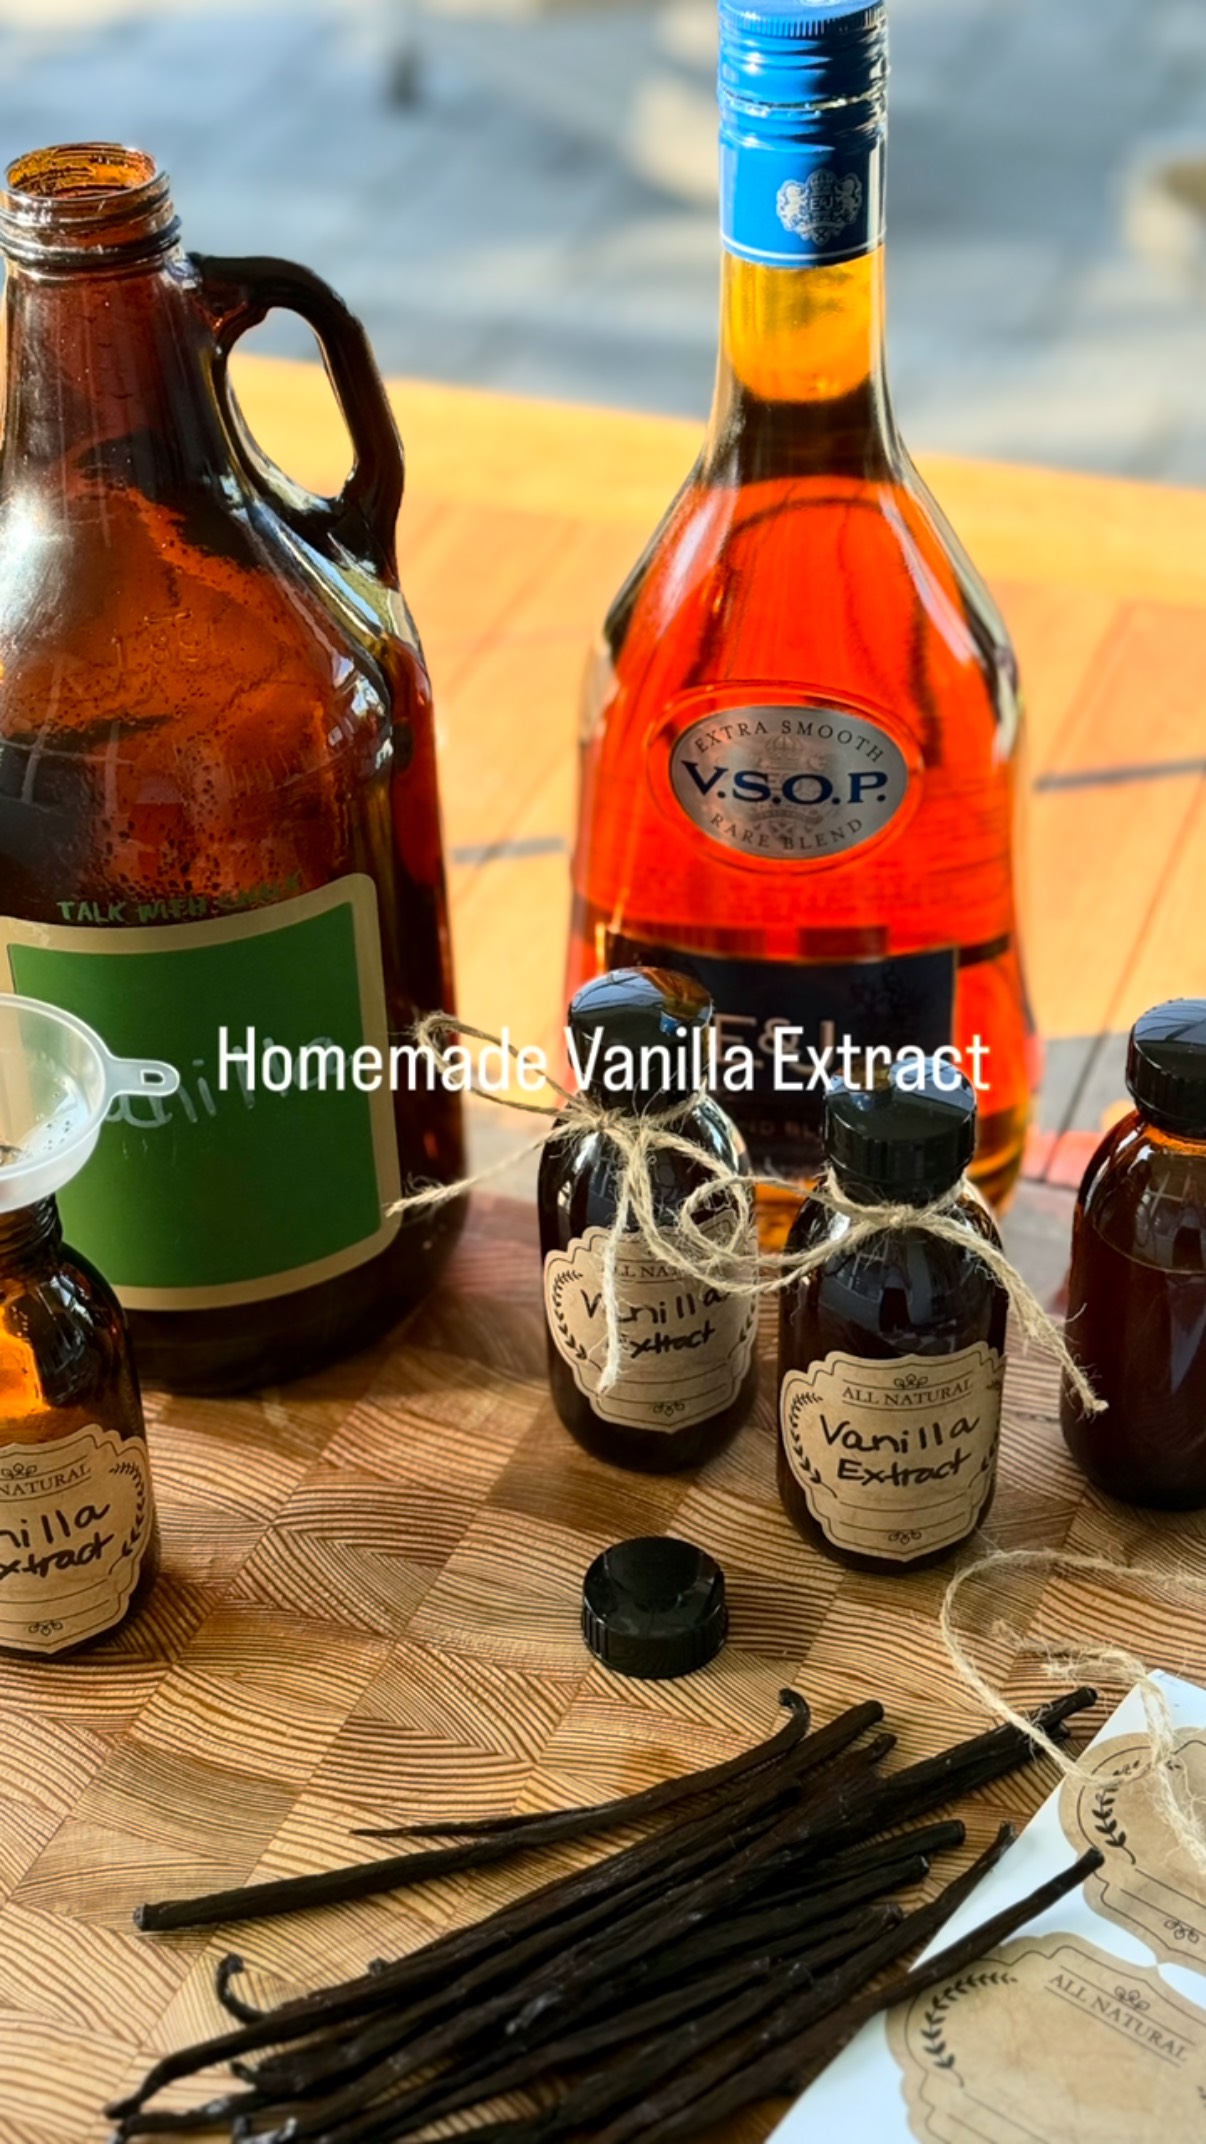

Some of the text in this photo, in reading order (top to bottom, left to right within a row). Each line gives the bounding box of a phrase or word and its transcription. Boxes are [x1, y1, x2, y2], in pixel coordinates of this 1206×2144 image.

[693, 719, 885, 763] EXTRA SMOOTH
[680, 759, 889, 806] V.S.O.P.
[709, 812, 863, 850] RARE BLEND
[56, 900, 127, 923] TALK
[580, 1286, 732, 1325] Vnilla
[842, 1378, 974, 1406] ALL NATURAL
[819, 1413, 981, 1454] Vanilla
[836, 1447, 973, 1487] Extract
[1048, 1973, 1189, 2063] ALL NATURAL
